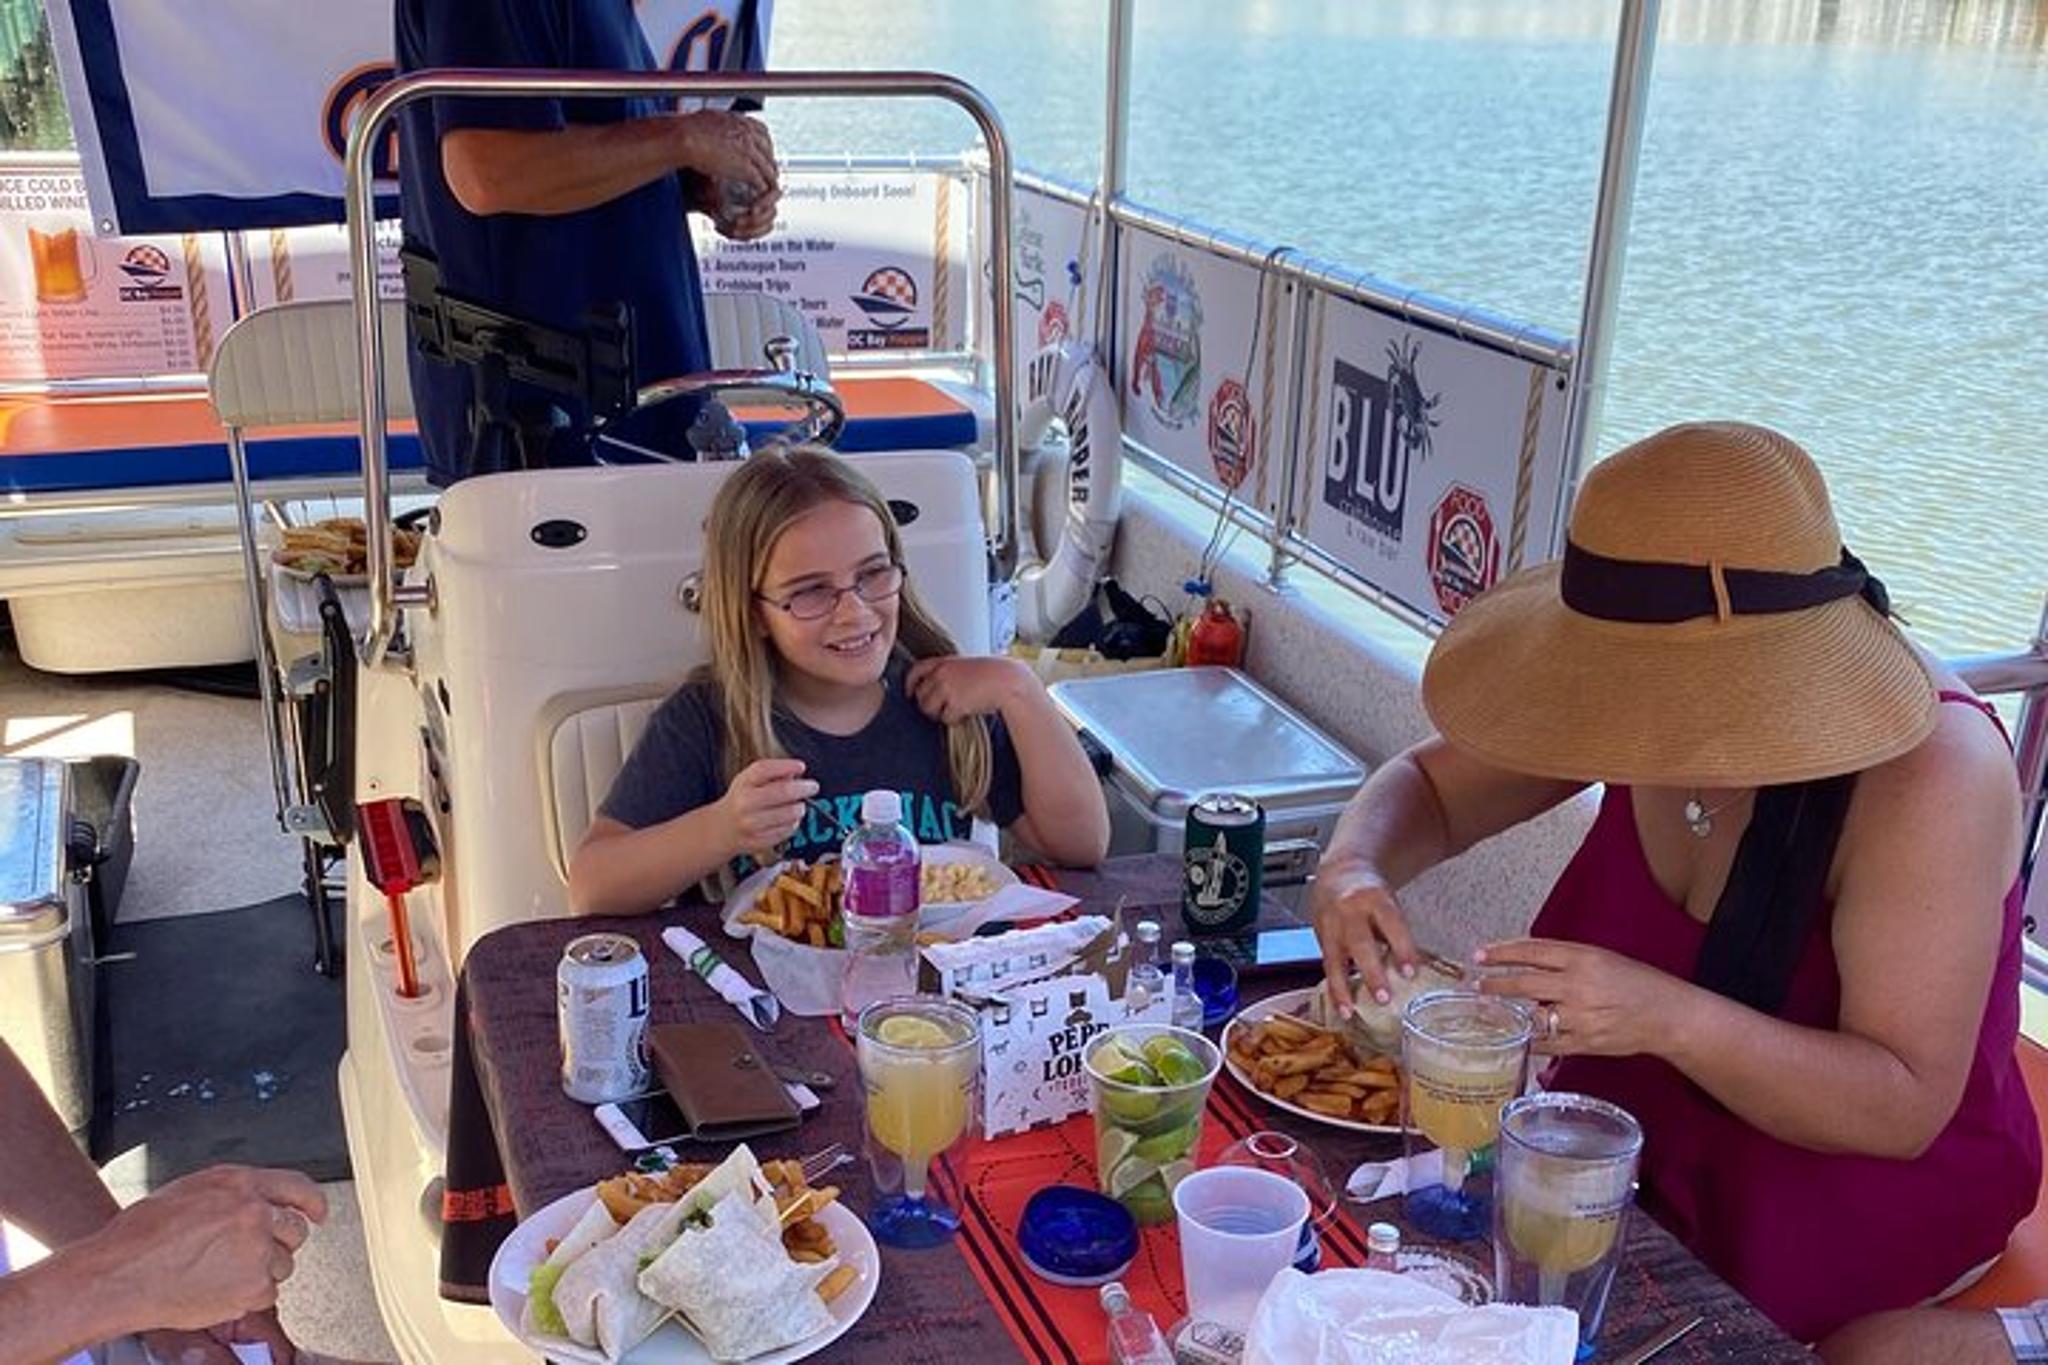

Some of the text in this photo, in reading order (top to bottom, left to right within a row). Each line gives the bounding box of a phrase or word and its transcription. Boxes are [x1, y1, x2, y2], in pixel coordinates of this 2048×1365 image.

[782, 184, 826, 202] Coming
[830, 183, 880, 199] Onboard
[806, 239, 836, 252] Water
[765, 278, 791, 293] Trips
[866, 332, 886, 348] Bay
[1328, 384, 1408, 513] BLU
